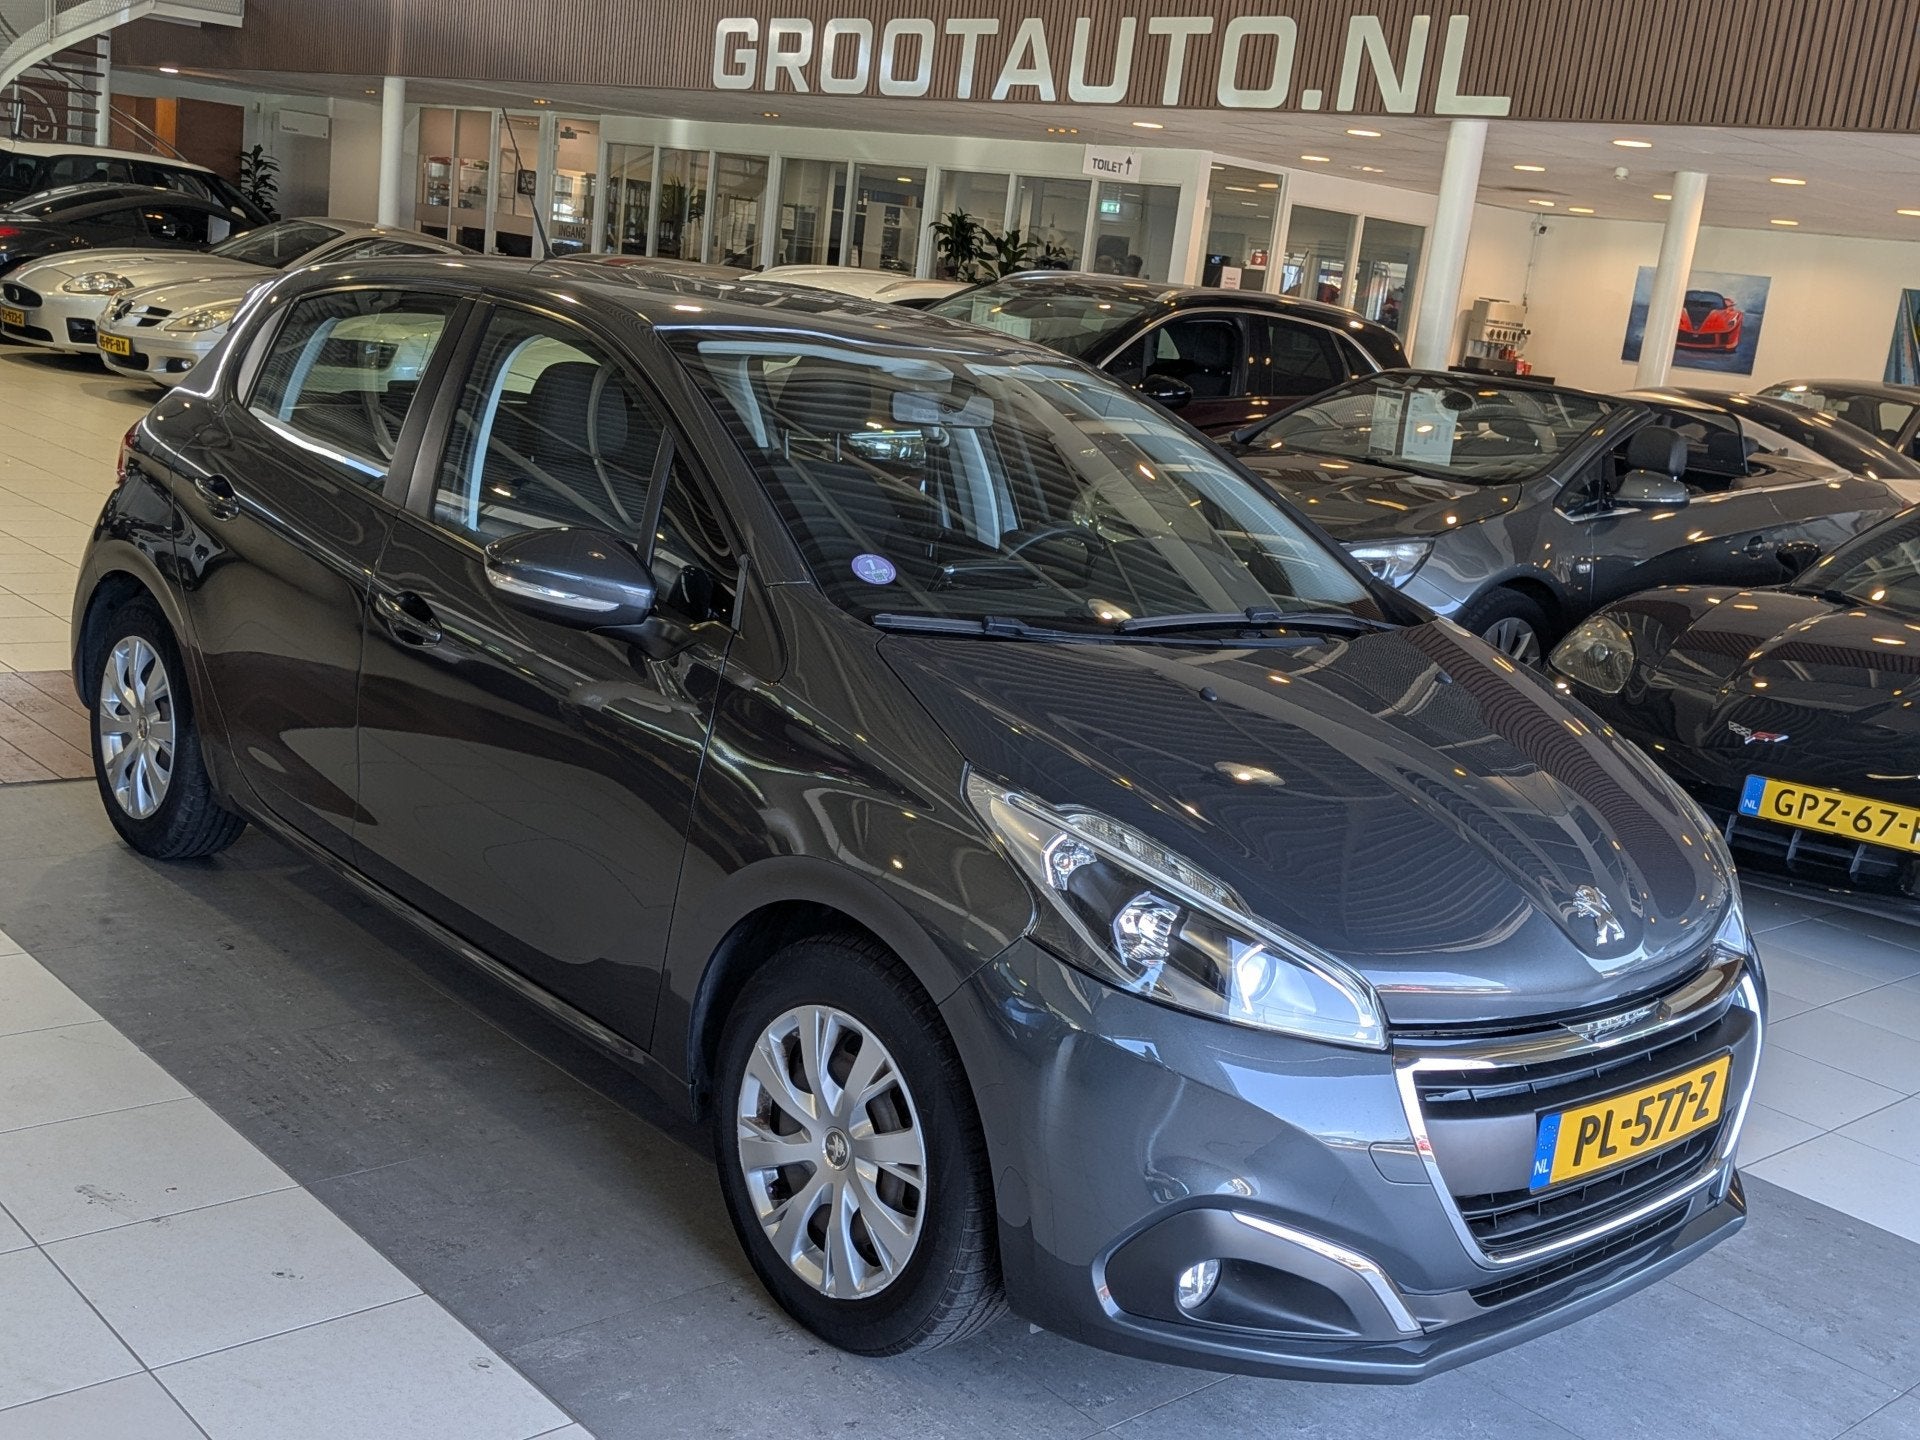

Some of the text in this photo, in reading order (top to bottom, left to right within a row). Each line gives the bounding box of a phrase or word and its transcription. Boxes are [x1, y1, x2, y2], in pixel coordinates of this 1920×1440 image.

[712, 14, 1512, 117] GROOTAUTO.NL
[1092, 157, 1123, 173] TOILET
[558, 224, 586, 240] INGANG
[1743, 799, 1758, 810] NL
[1572, 1070, 1717, 1167] PL-577-Z
[1534, 1158, 1549, 1176] NL
